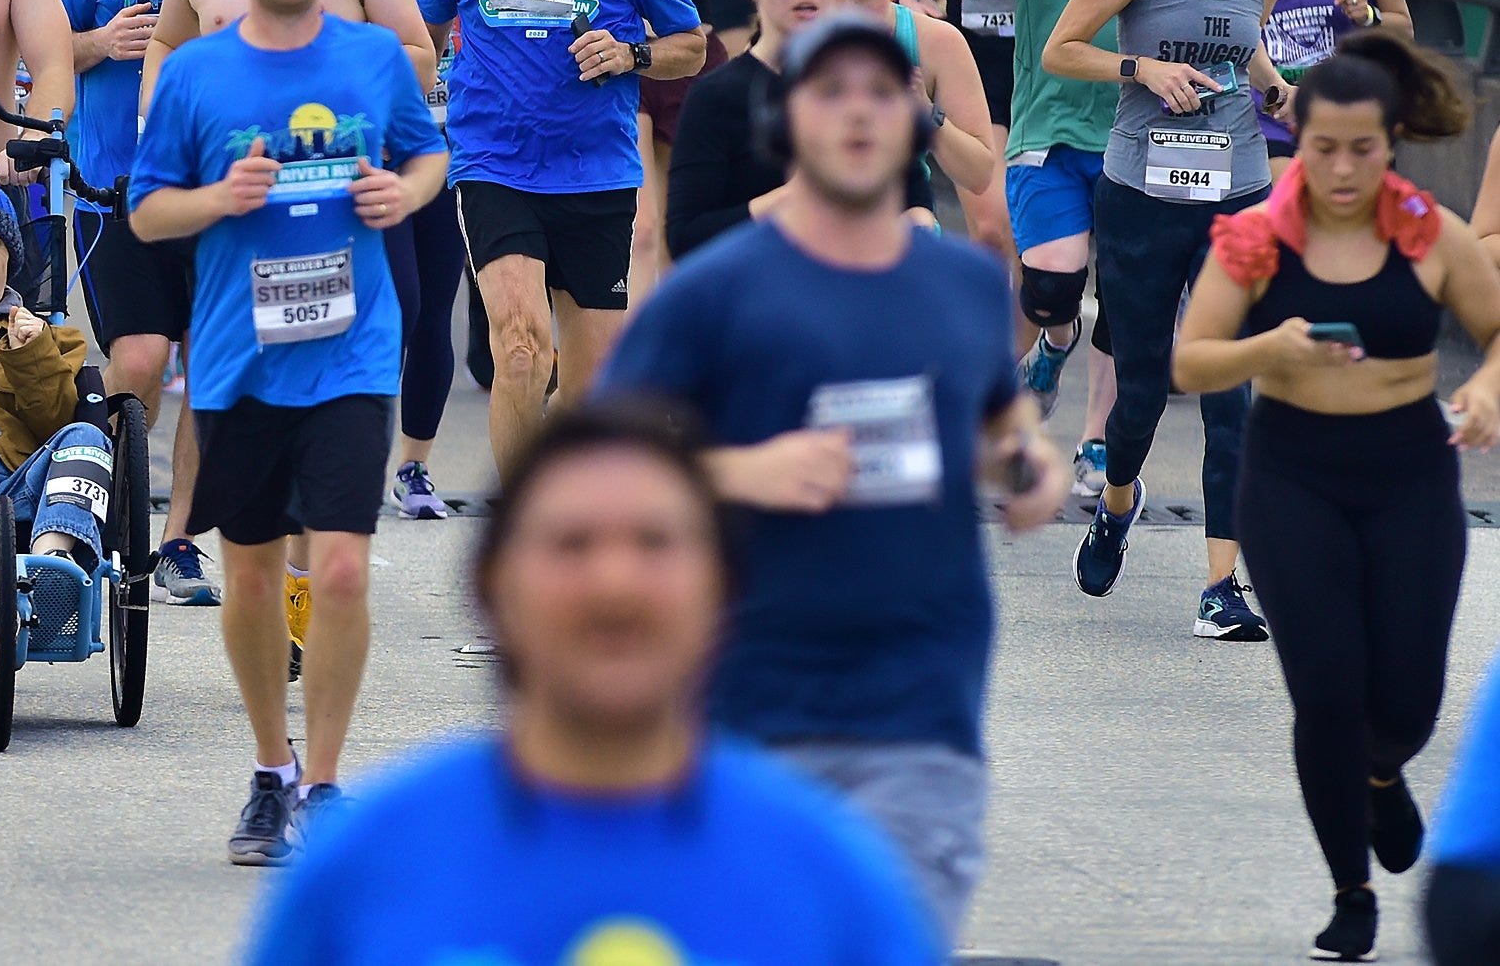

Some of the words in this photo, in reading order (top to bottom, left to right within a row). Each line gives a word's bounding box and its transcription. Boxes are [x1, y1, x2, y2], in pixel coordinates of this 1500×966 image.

[572, 2, 590, 13] UN
[1275, 5, 1334, 23] PAVEMENT
[981, 14, 1014, 27] 7421
[1204, 17, 1231, 37] THE
[1153, 134, 1178, 142] GATE
[1179, 135, 1208, 143] RIVER
[1209, 136, 1228, 144] RUN
[278, 165, 330, 183] RIVER
[1169, 170, 1211, 186] 6944
[257, 262, 286, 275] GATE
[287, 258, 323, 272] RIVER
[257, 277, 351, 303] STEPHEN
[283, 303, 330, 324] 5057
[57, 448, 82, 458] GATE
[72, 479, 106, 506] 3731
